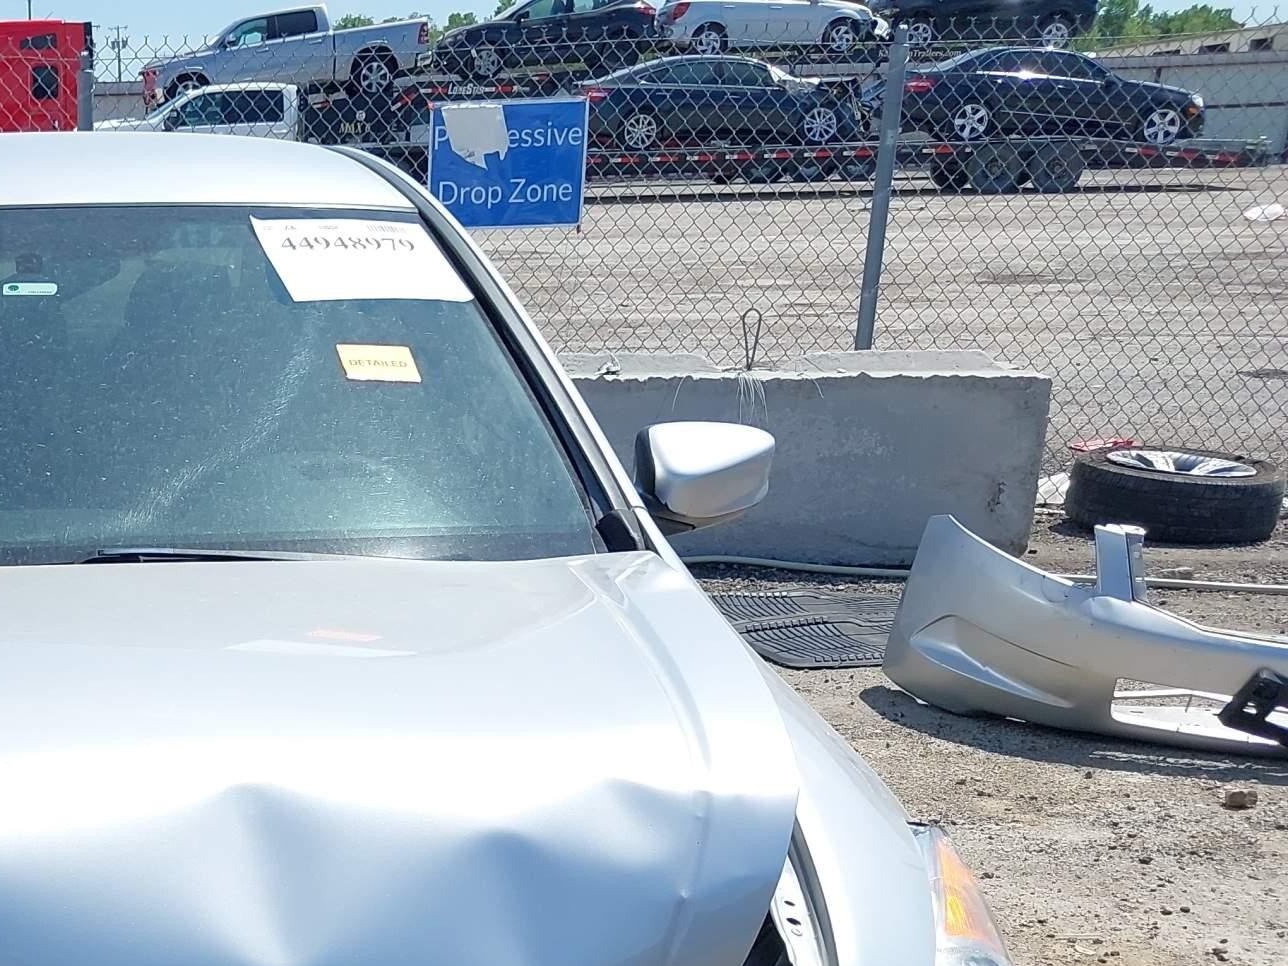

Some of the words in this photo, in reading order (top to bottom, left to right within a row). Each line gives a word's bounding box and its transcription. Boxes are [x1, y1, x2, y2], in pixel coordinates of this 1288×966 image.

[434, 121, 583, 150] Pessive
[439, 180, 503, 210] Drop
[508, 178, 573, 203] Zone
[281, 236, 415, 251] 44948979
[348, 359, 408, 368] DETAILED
